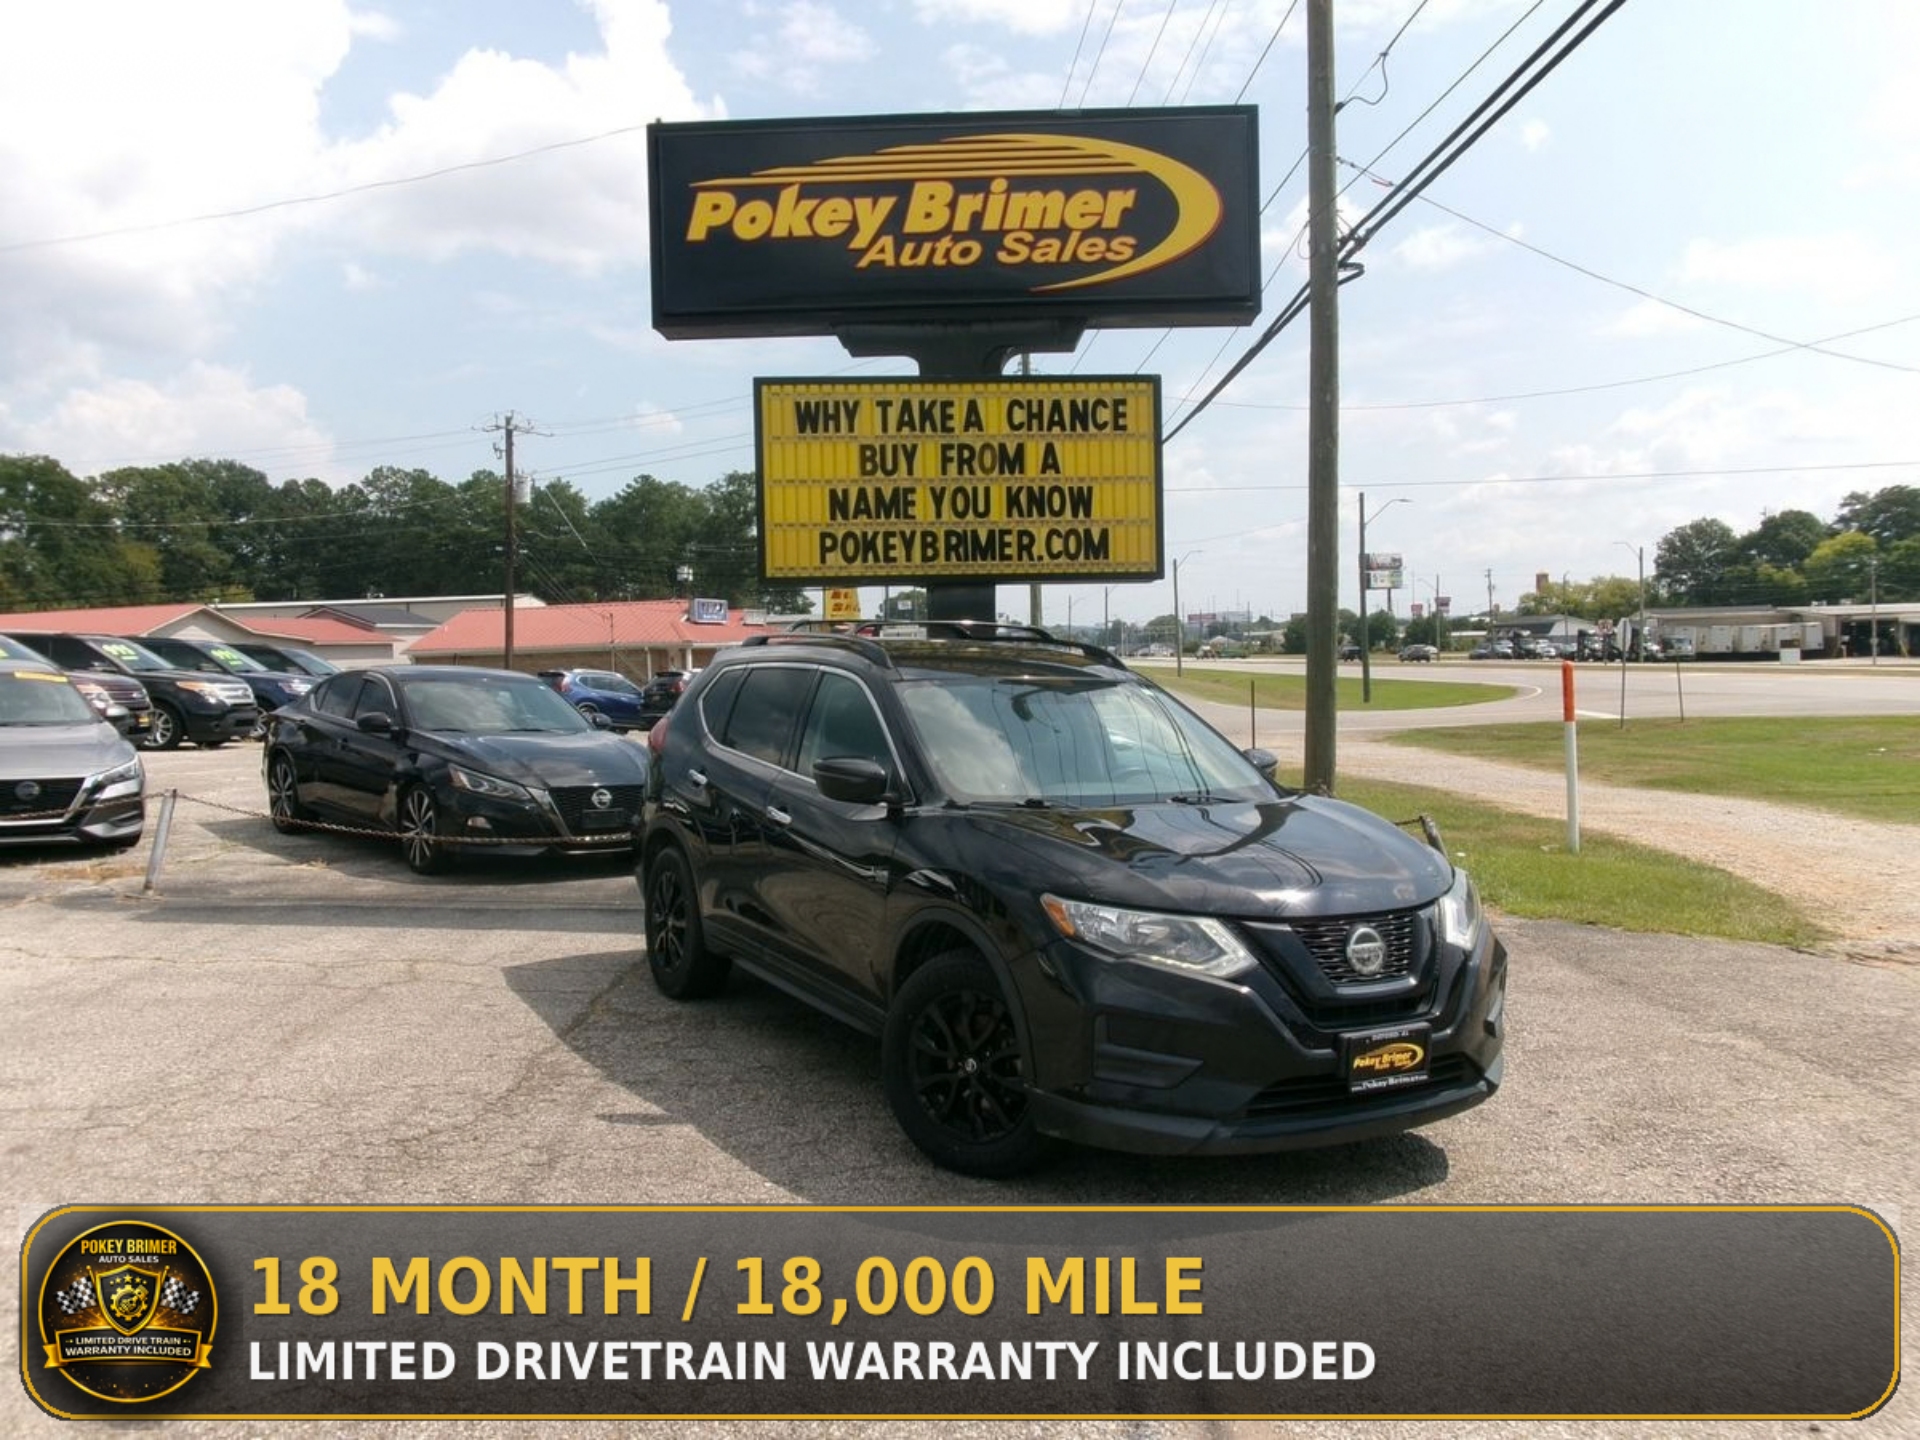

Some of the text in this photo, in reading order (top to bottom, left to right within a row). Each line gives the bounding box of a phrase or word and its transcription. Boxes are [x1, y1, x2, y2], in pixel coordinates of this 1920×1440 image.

[686, 178, 1138, 249] Pokey Brimer
[856, 230, 1138, 268] Auto Sales
[795, 398, 1128, 434] WHY TAKE A CHANCE
[859, 442, 1061, 477] BUY FROM A
[829, 485, 1093, 521] NAME YOU KNOW
[819, 528, 1109, 564] POKEYBRIMER.COM
